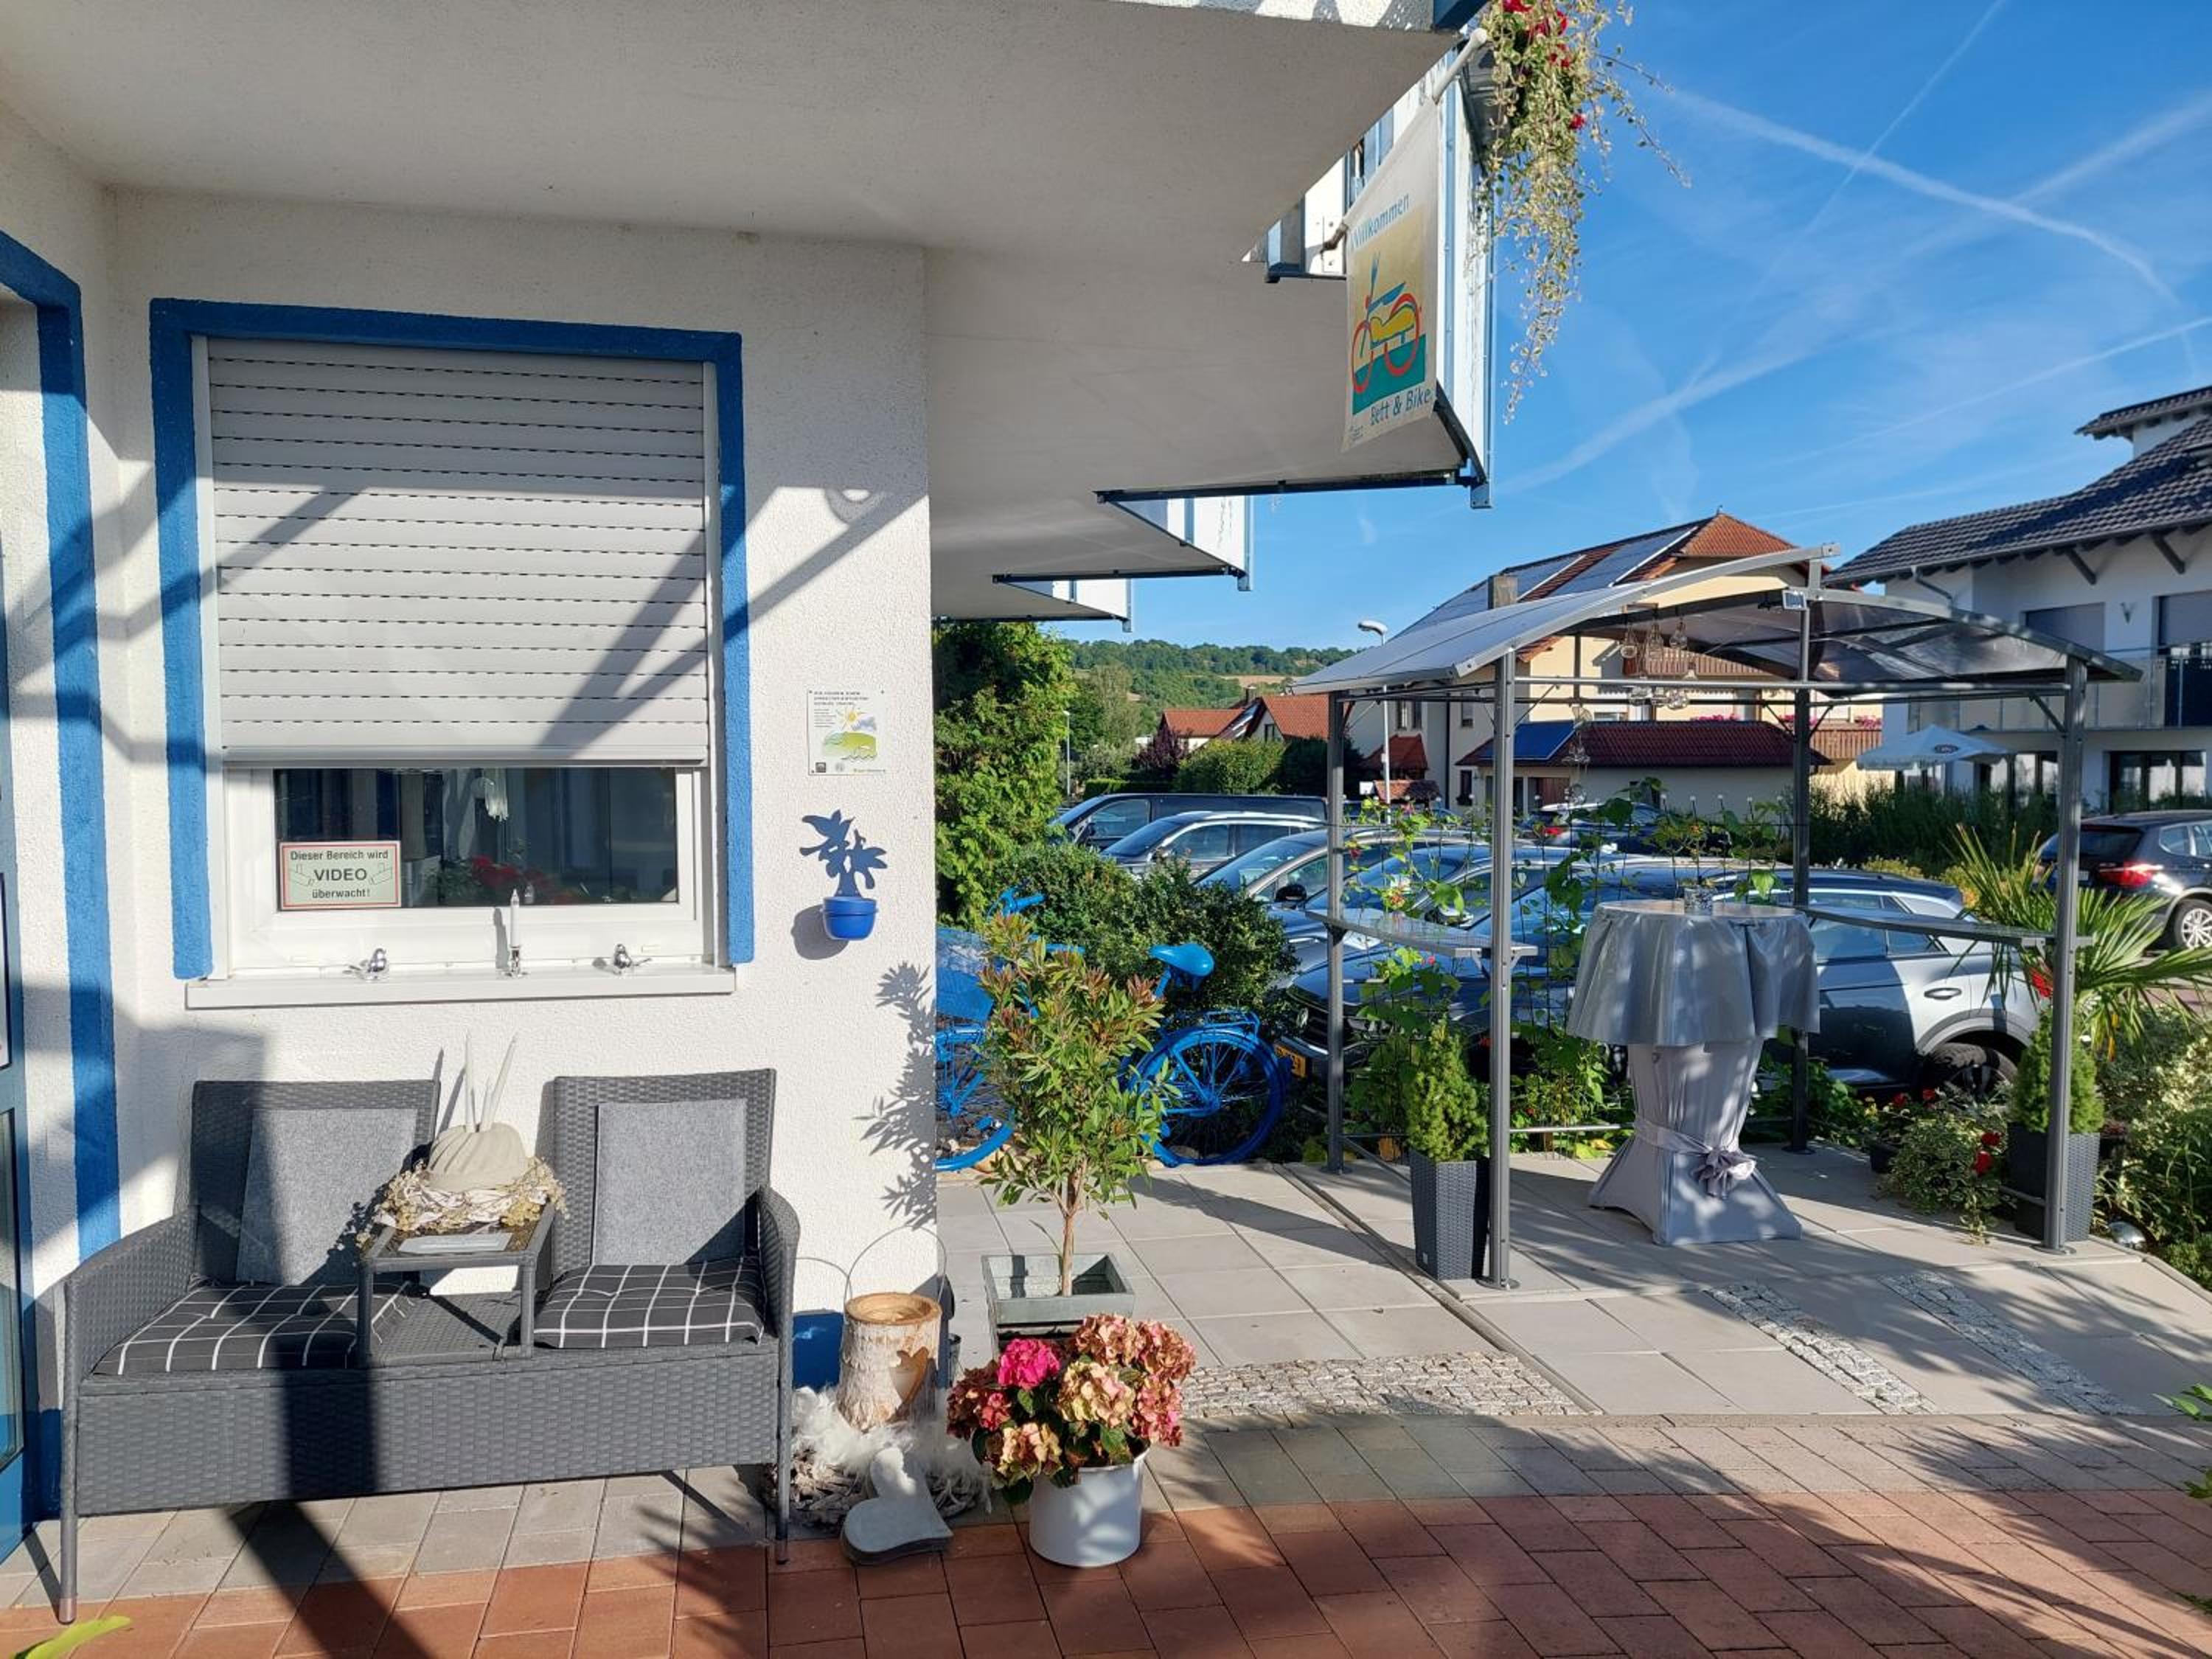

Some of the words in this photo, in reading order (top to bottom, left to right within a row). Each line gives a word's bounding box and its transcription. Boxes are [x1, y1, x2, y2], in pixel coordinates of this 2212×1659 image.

[1393, 396, 1402, 417] &
[1405, 387, 1430, 411] Bike
[290, 851, 323, 860] Dieser
[327, 850, 364, 860] Bereich
[366, 850, 389, 859] wird
[313, 868, 367, 881] VIDEO
[312, 888, 370, 899] überwacht!
